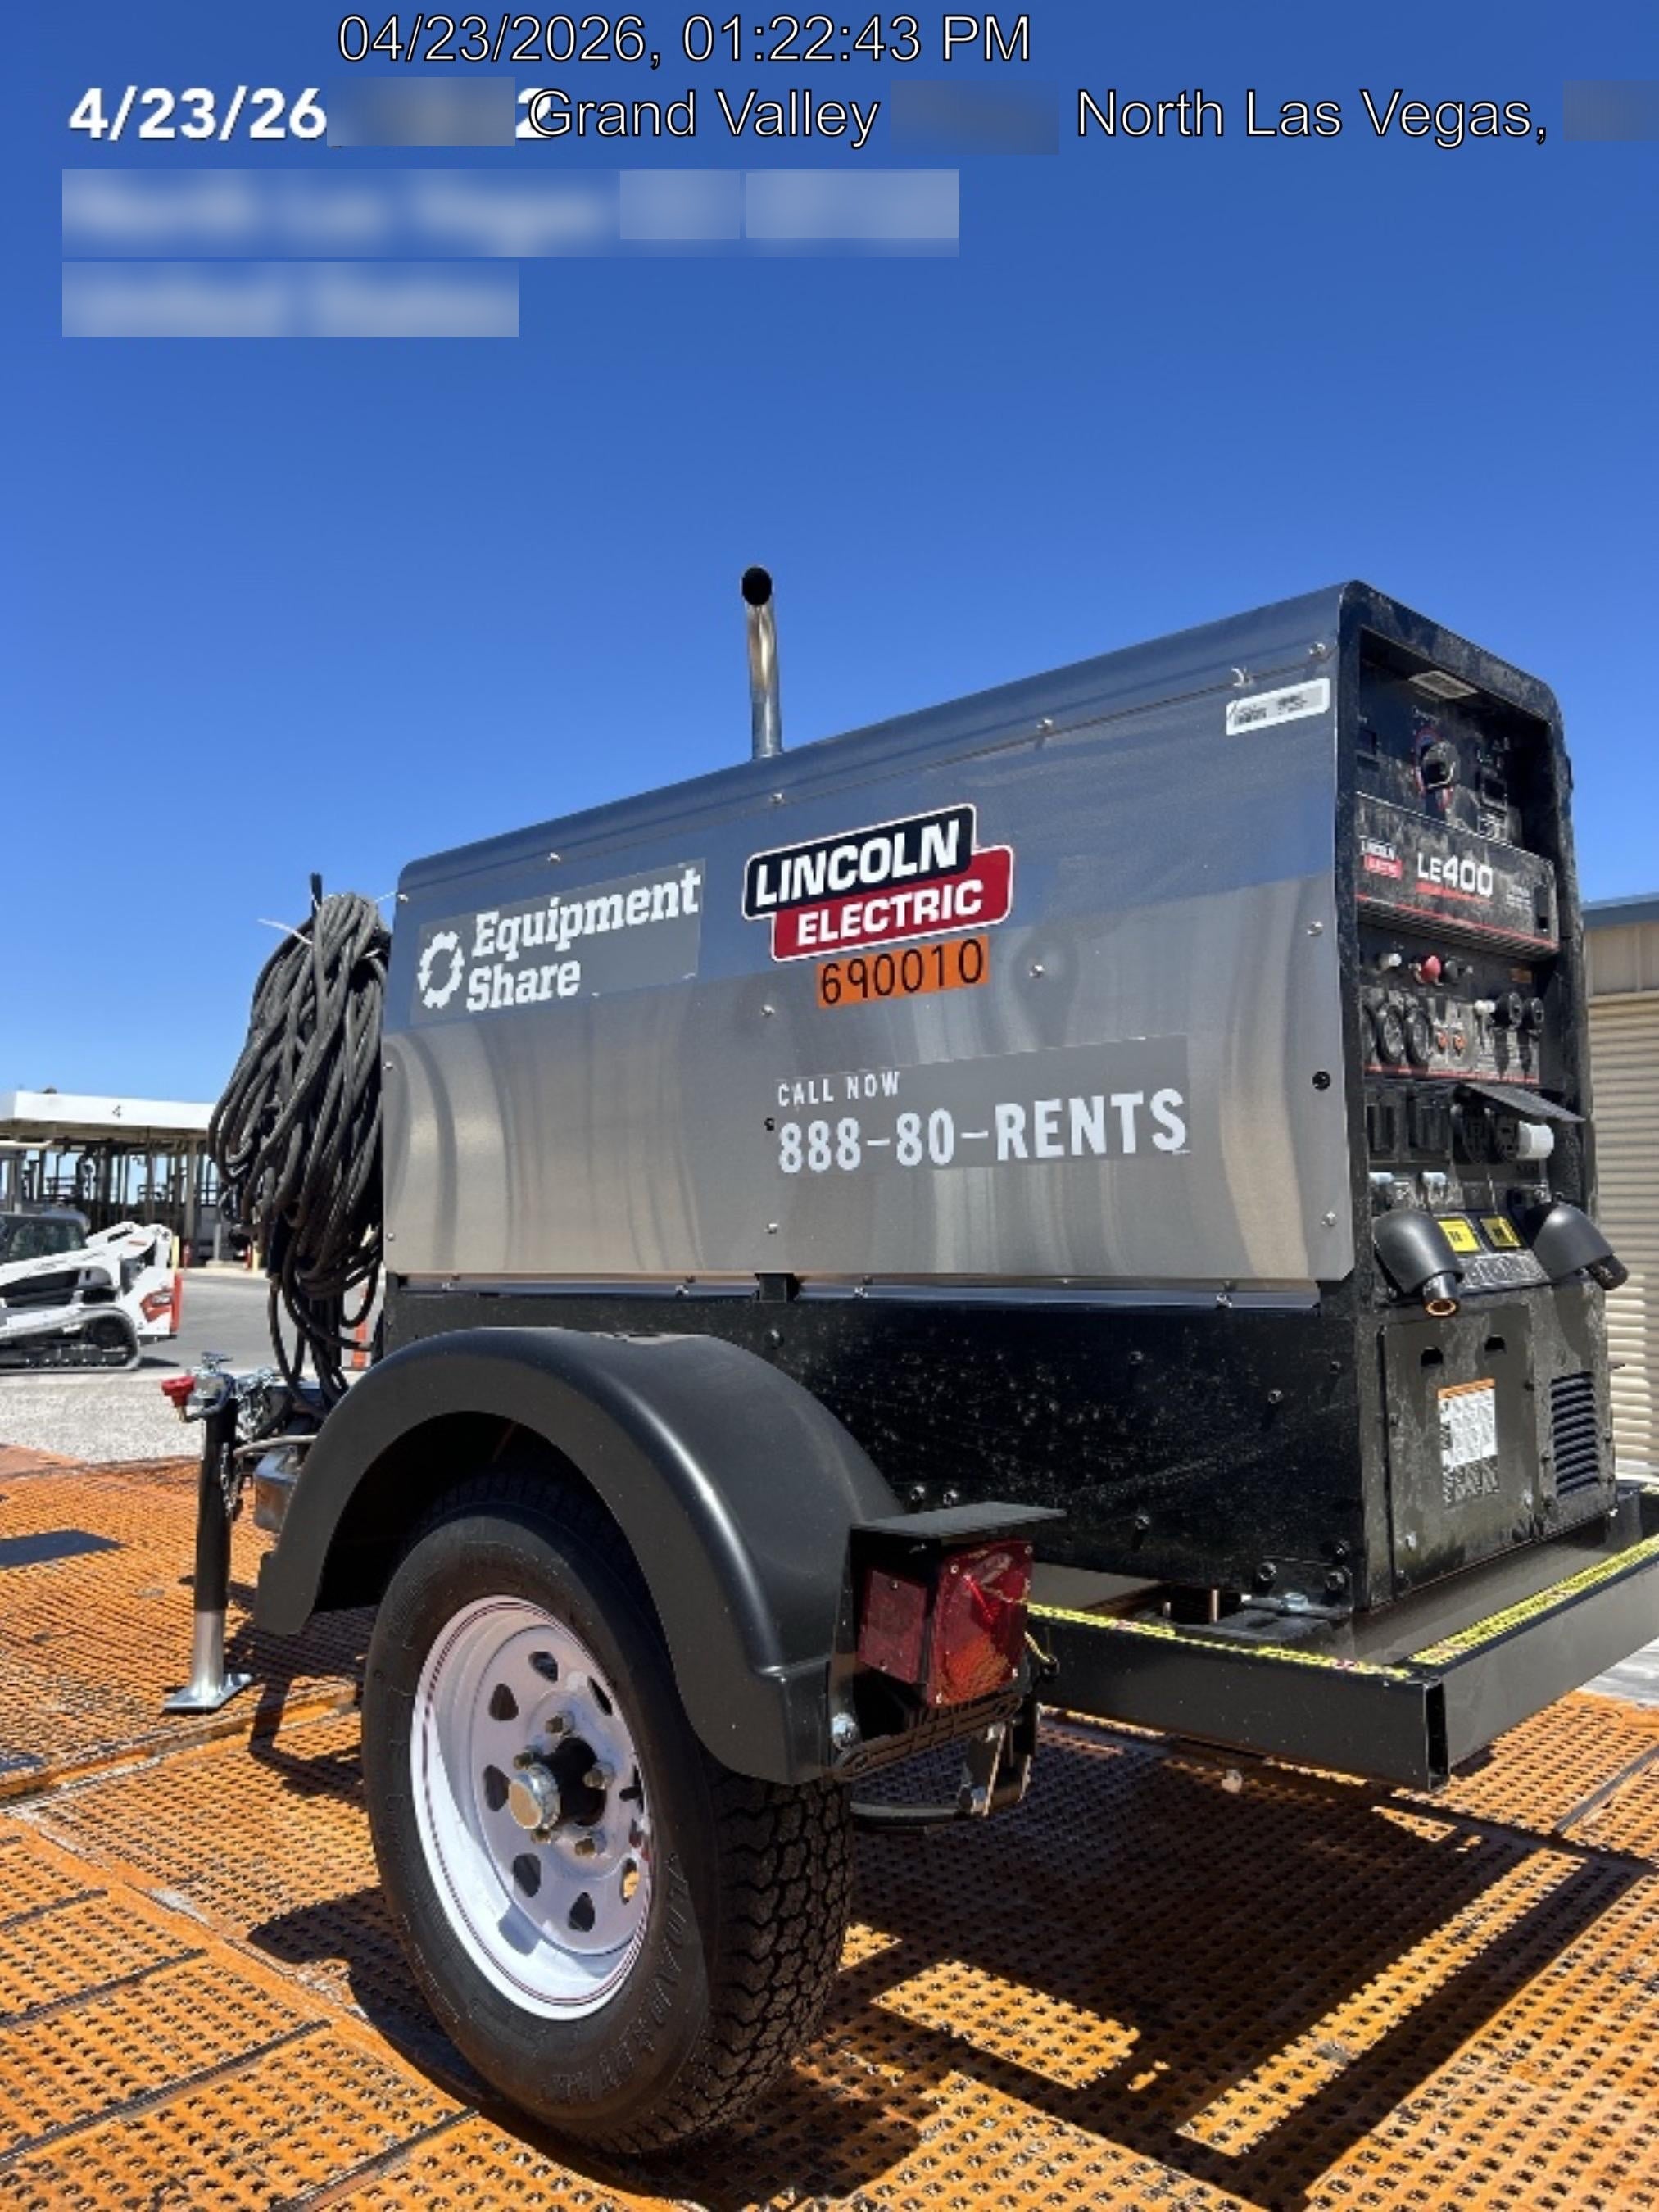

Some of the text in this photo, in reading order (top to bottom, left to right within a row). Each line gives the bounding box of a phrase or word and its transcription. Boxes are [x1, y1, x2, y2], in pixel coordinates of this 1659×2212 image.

[755, 818, 960, 907] LINCOLN
[1417, 852, 1494, 898] LE400
[471, 868, 701, 962] Equipment
[796, 879, 983, 946] ELECTRIC
[466, 960, 582, 1013] Share
[821, 938, 983, 1005] 690010
[777, 1071, 901, 1107] CALL NOW
[778, 1089, 1186, 1174] 888-80-RENTS
